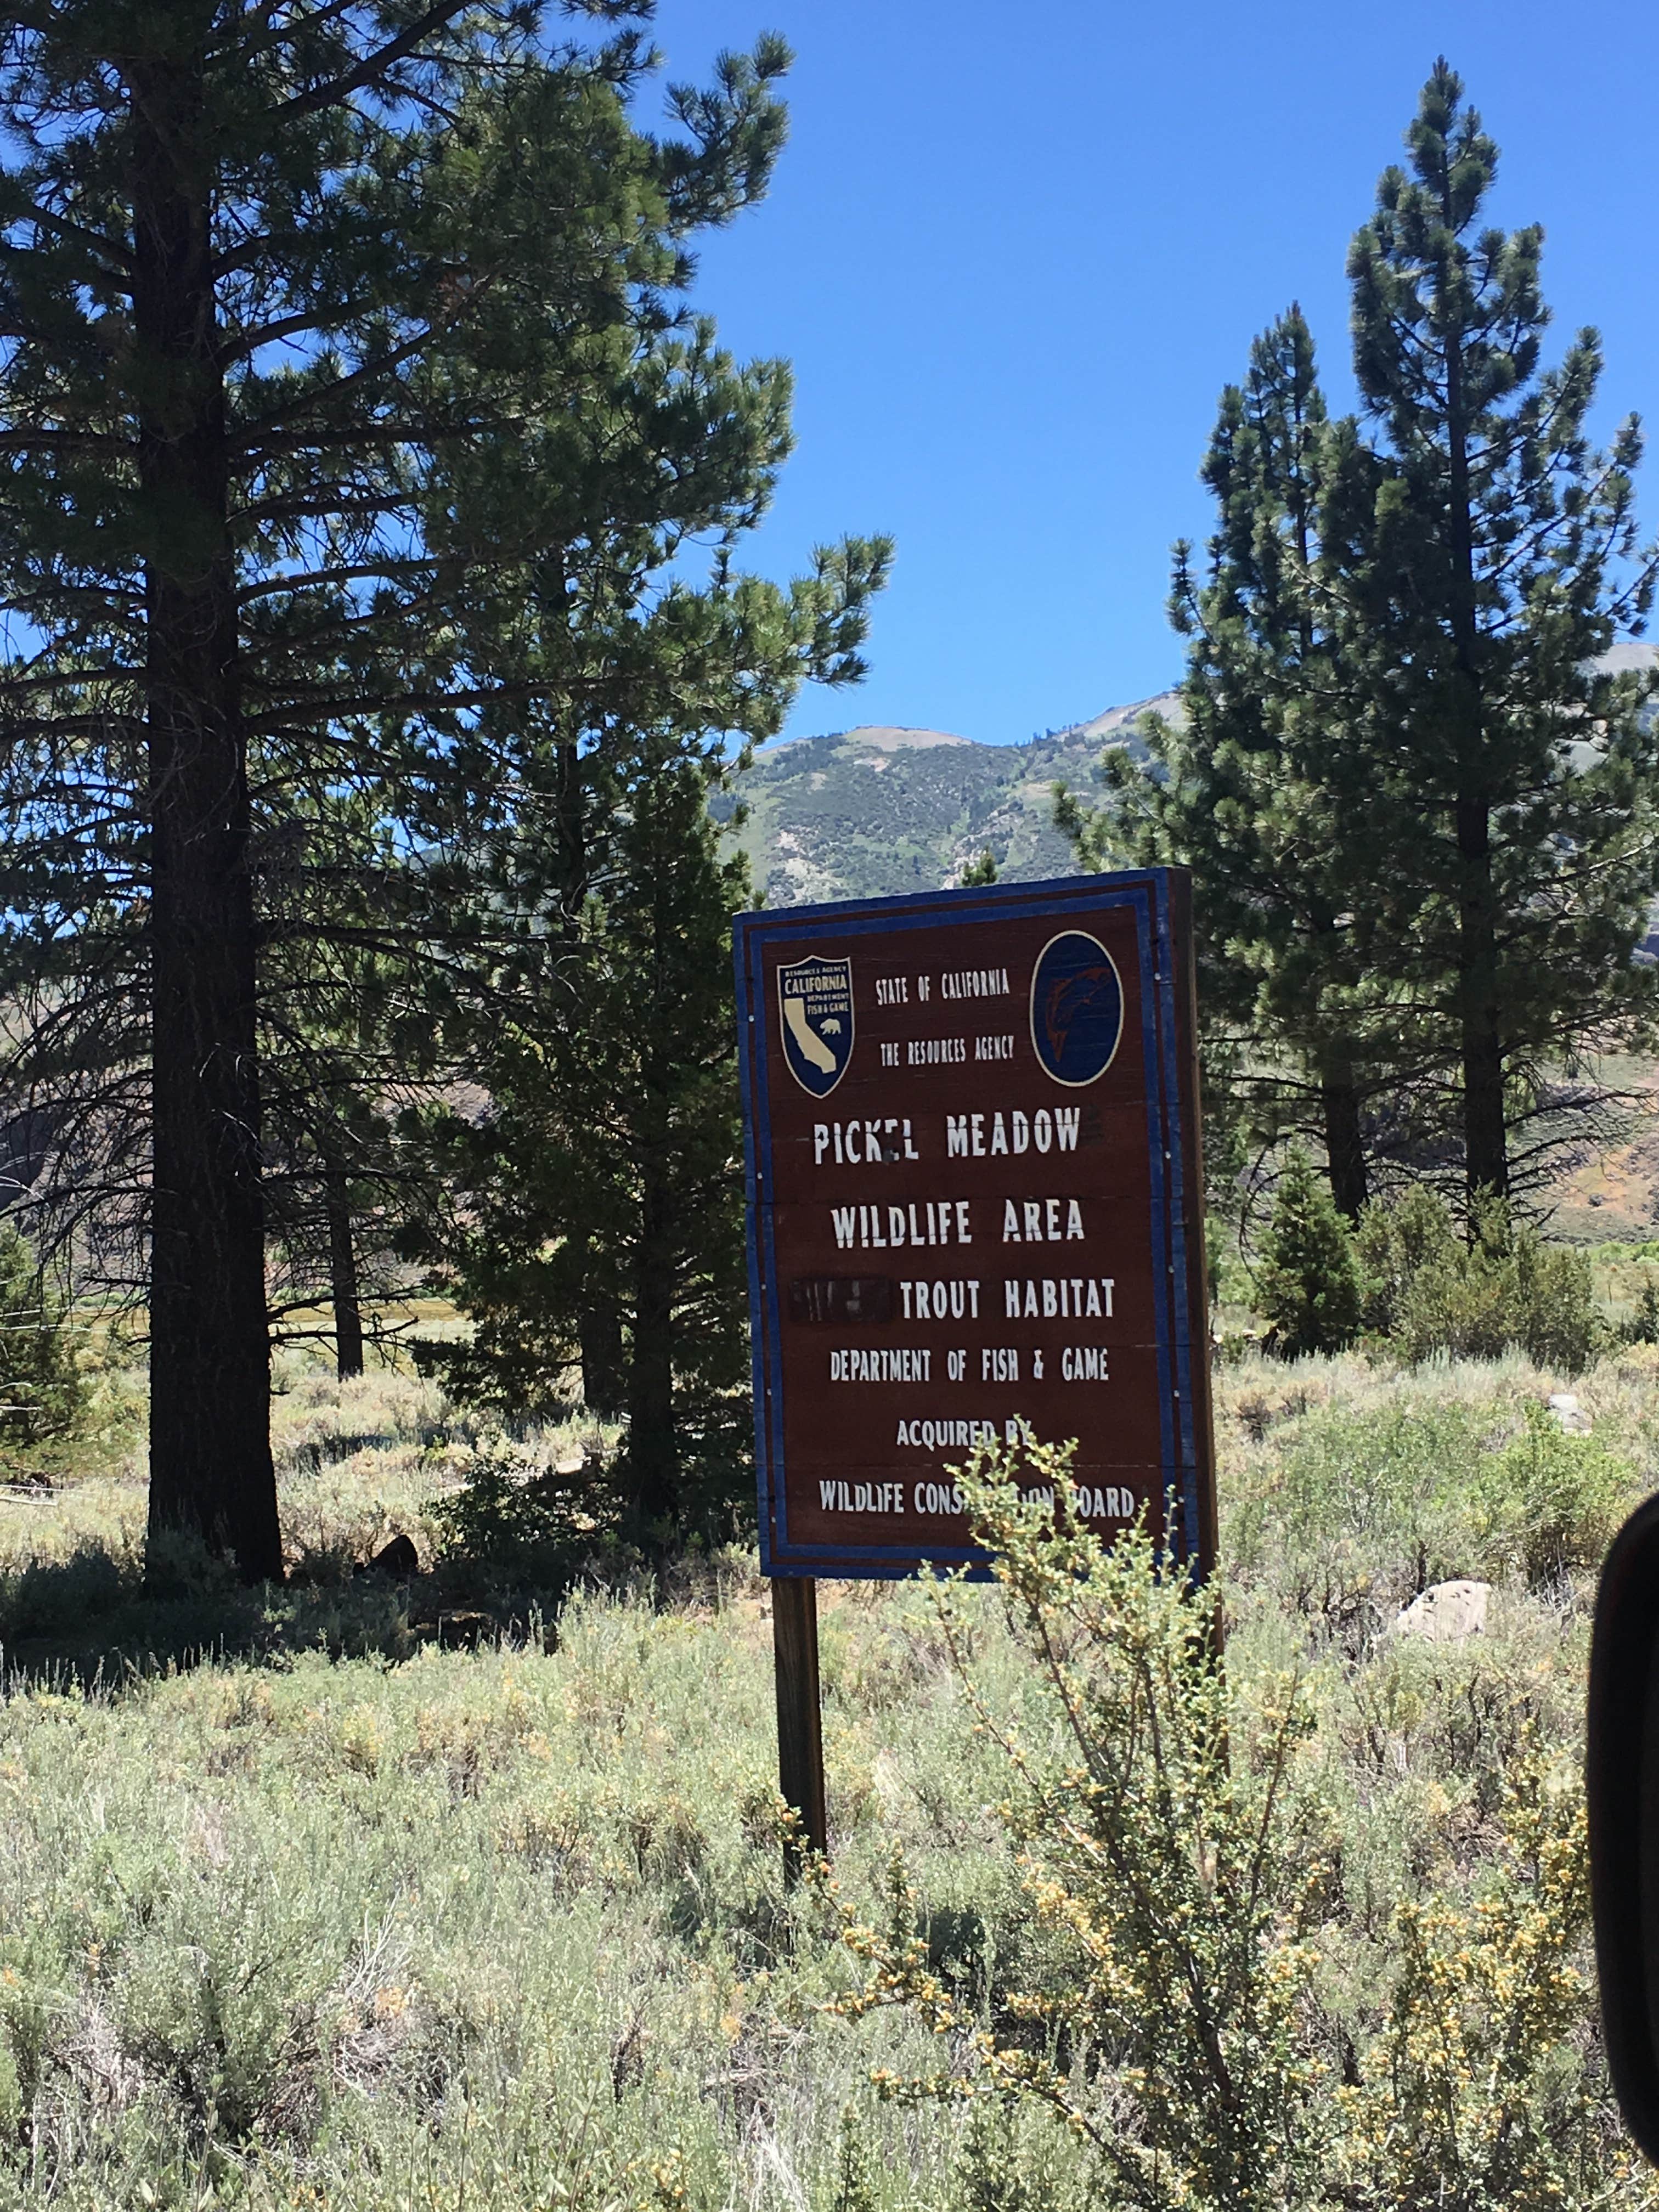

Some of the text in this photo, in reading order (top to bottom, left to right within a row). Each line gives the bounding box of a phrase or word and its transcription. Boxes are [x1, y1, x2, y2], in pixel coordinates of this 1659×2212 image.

[785, 974, 847, 995] CALIFORNIA
[876, 968, 1010, 1006] STATE OF CALIFORNIA
[807, 1005, 822, 1015] FISH
[829, 1001, 849, 1013] GAME
[880, 1035, 1014, 1066] THE RESOURCES AGENCY
[946, 1107, 1080, 1158] MEADOW
[830, 1199, 1085, 1249] WILDLIFE AREA
[900, 1280, 980, 1319] TROUT
[1005, 1278, 1115, 1318] HABITAT
[831, 1347, 1109, 1382] DEPARTMENT OF FISH & GAME
[896, 1420, 995, 1452] ACQUIRED
[819, 1480, 904, 1513] WILDLIFE
